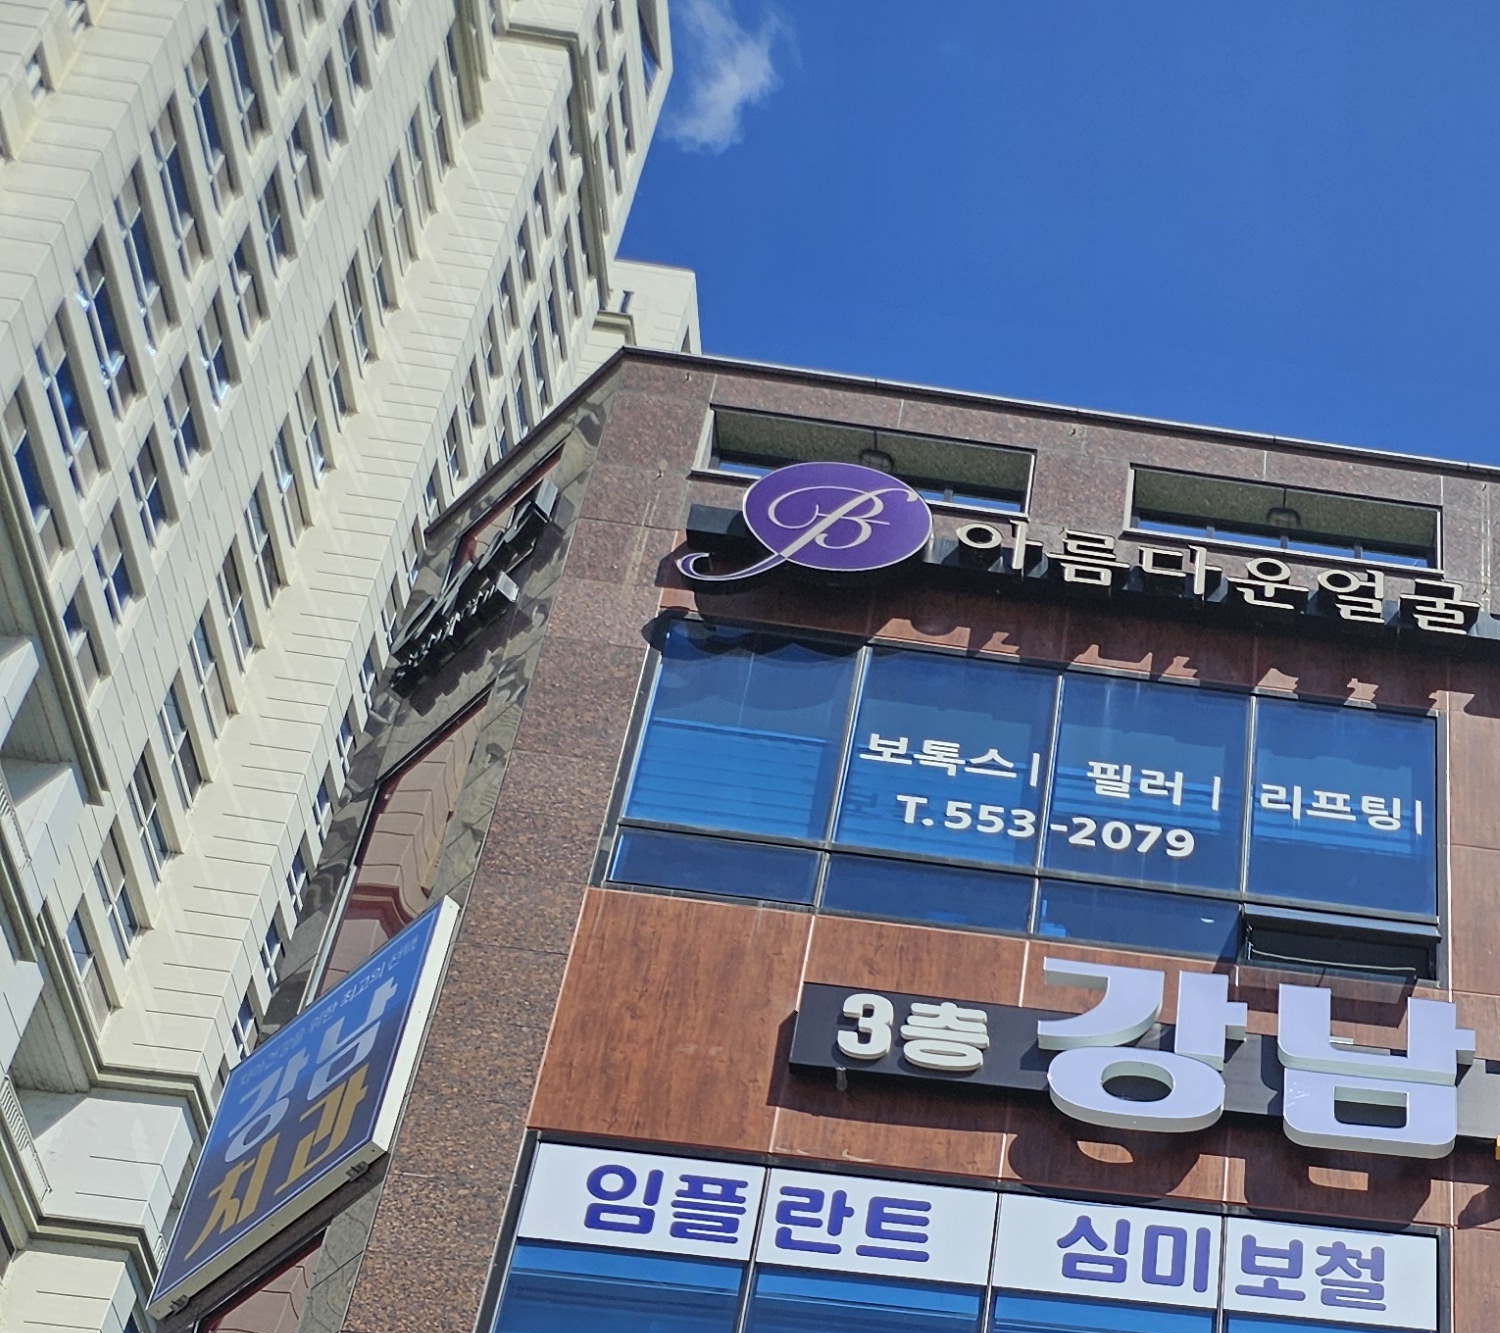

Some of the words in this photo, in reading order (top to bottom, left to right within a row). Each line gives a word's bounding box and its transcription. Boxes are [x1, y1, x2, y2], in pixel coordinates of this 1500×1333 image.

[955, 517, 1481, 634] 아름다운얼굴
[860, 732, 1017, 781] 보톡스
[1087, 760, 1185, 807] 필러
[1259, 783, 1404, 833] 리프팅
[896, 793, 1196, 859] T.553-2079
[225, 975, 399, 1163] 강남
[836, 992, 991, 1072] 3층
[184, 1064, 371, 1262] 치과
[583, 1162, 933, 1264] 임플란트
[1056, 1214, 1389, 1313] 심미보철
